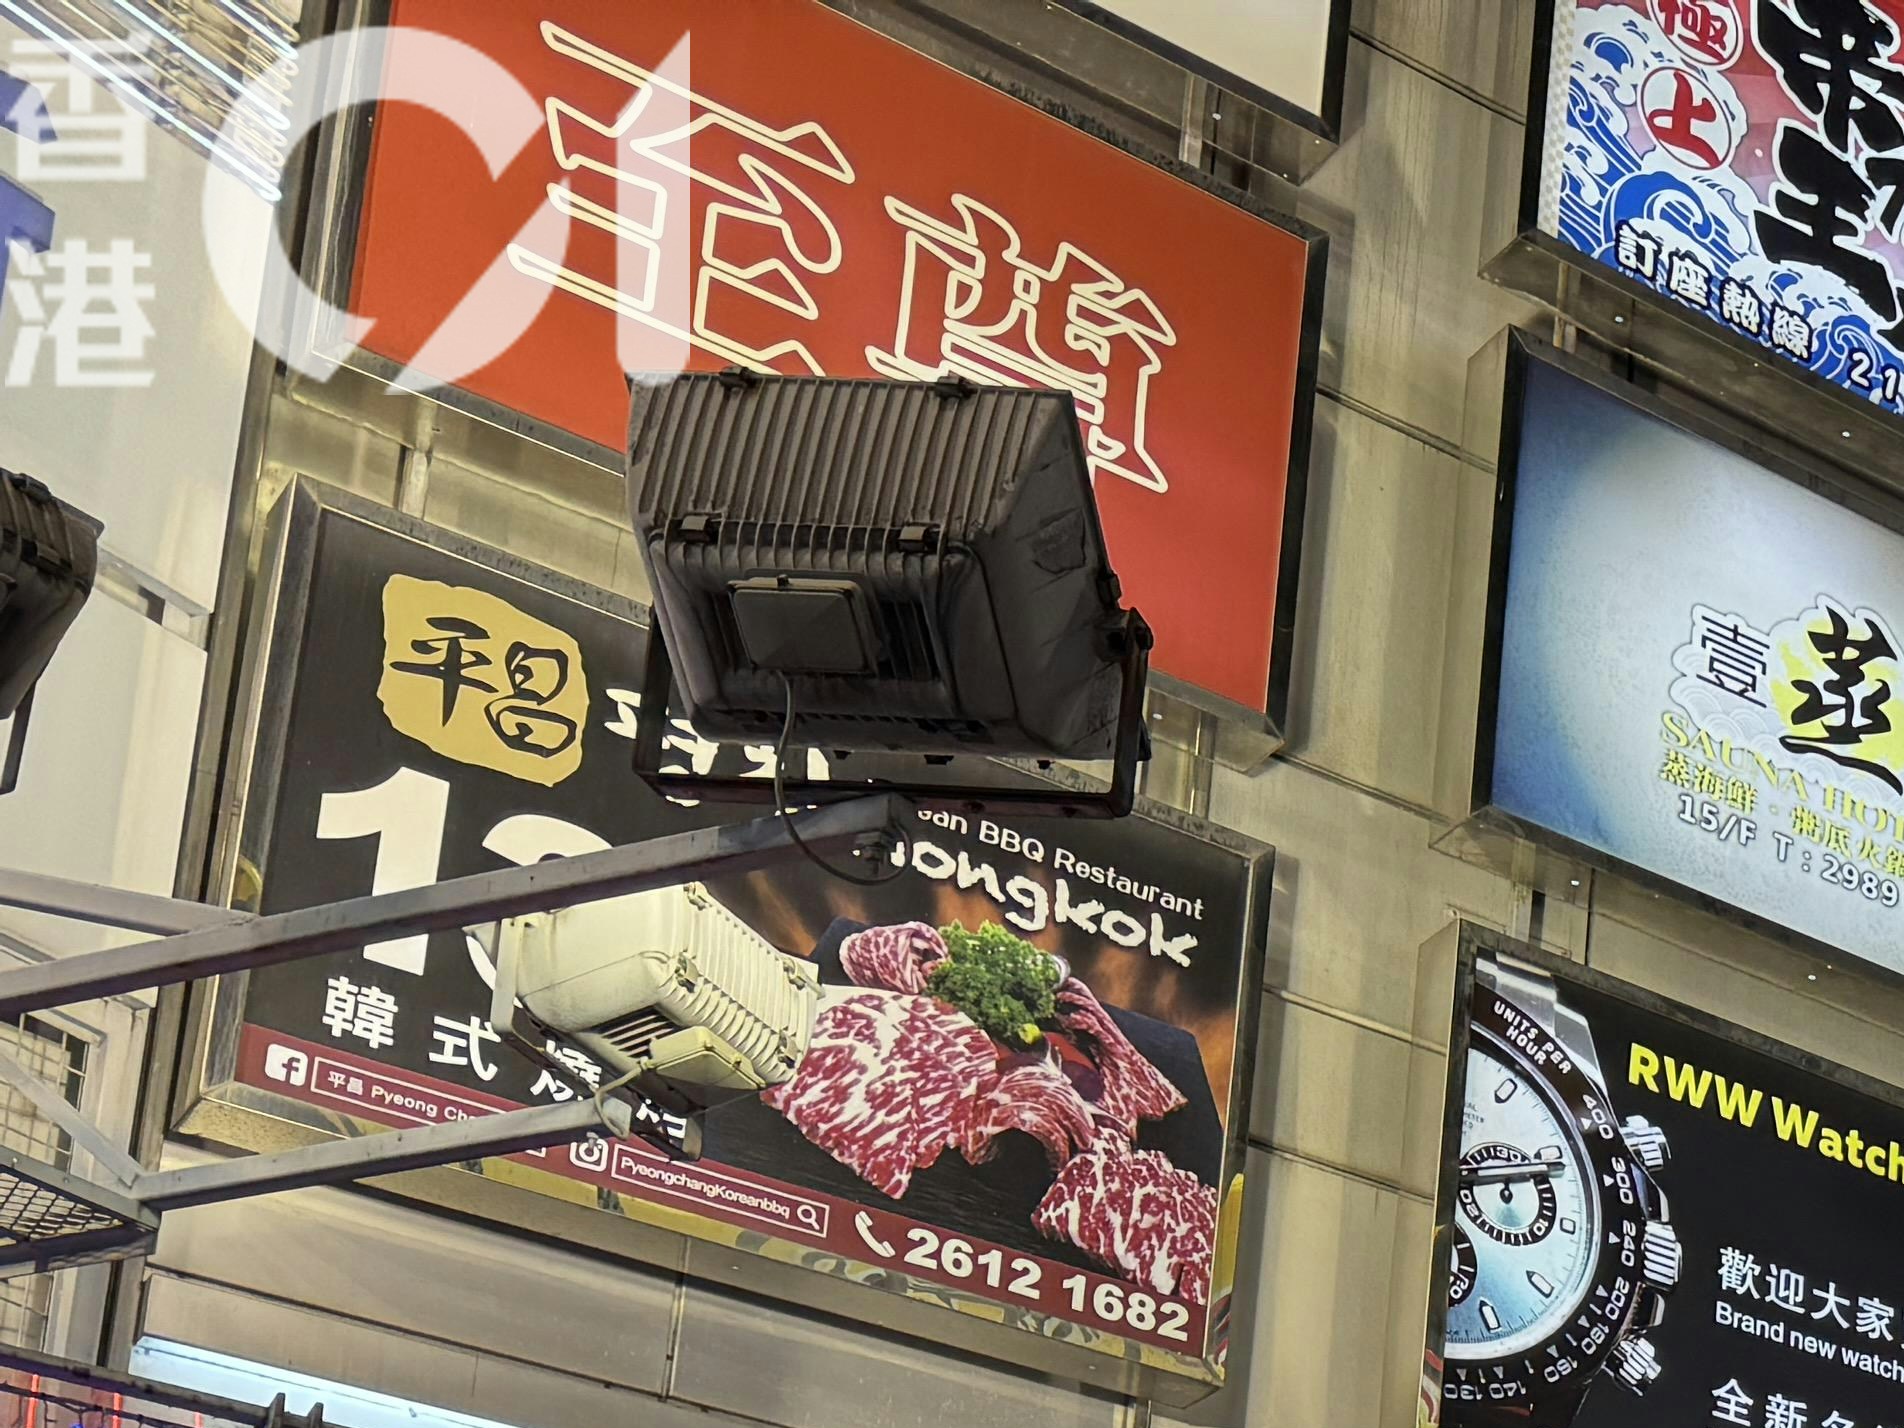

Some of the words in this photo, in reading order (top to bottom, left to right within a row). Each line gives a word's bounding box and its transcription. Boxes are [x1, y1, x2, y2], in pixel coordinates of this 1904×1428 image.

[1615, 225, 1813, 360] 訂座熱線
[1660, 710, 1810, 802] SAUNA
[979, 818, 1046, 863] BBQ
[1054, 847, 1205, 920] Restaurant
[1679, 793, 1758, 847] 15/F
[1821, 853, 1901, 908] 2989
[852, 840, 1200, 969] ongkok
[1493, 1000, 1539, 1041] UNITS
[1542, 1038, 1572, 1075] PER
[1505, 1025, 1549, 1068] HOUR
[327, 1069, 364, 1096] 平昌
[371, 1083, 438, 1117] Pyeong
[1581, 1094, 1614, 1141] 400
[1627, 1042, 1763, 1130] RWW
[620, 1152, 791, 1223] PyeongchangKoreanbbq
[1610, 1156, 1635, 1205] 300
[1620, 1220, 1637, 1268] 240
[904, 1226, 1042, 1301] 2612
[1061, 1273, 1191, 1343] 1682
[1715, 1300, 1785, 1352] Brand
[1789, 1331, 1837, 1362] new
